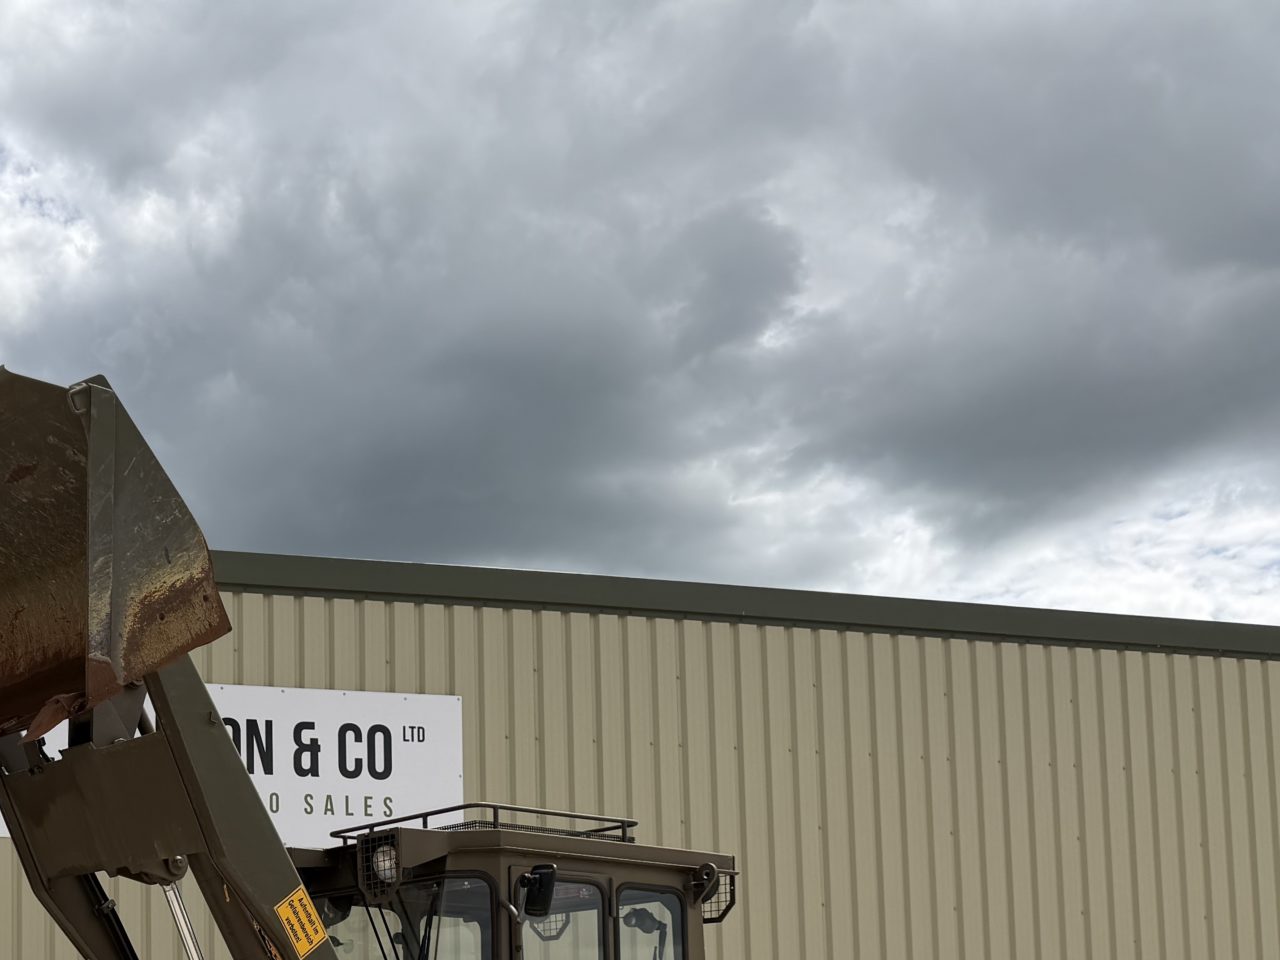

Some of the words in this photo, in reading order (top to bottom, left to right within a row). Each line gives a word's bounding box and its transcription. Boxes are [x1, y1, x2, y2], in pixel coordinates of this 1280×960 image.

[293, 721, 321, 777] &
[337, 722, 393, 780] CO
[402, 725, 425, 742] LTD
[303, 793, 394, 818] SALES
[288, 899, 314, 945] Gefahrenbereich
[297, 897, 316, 928] Aufenthalt
[312, 923, 319, 936] im
